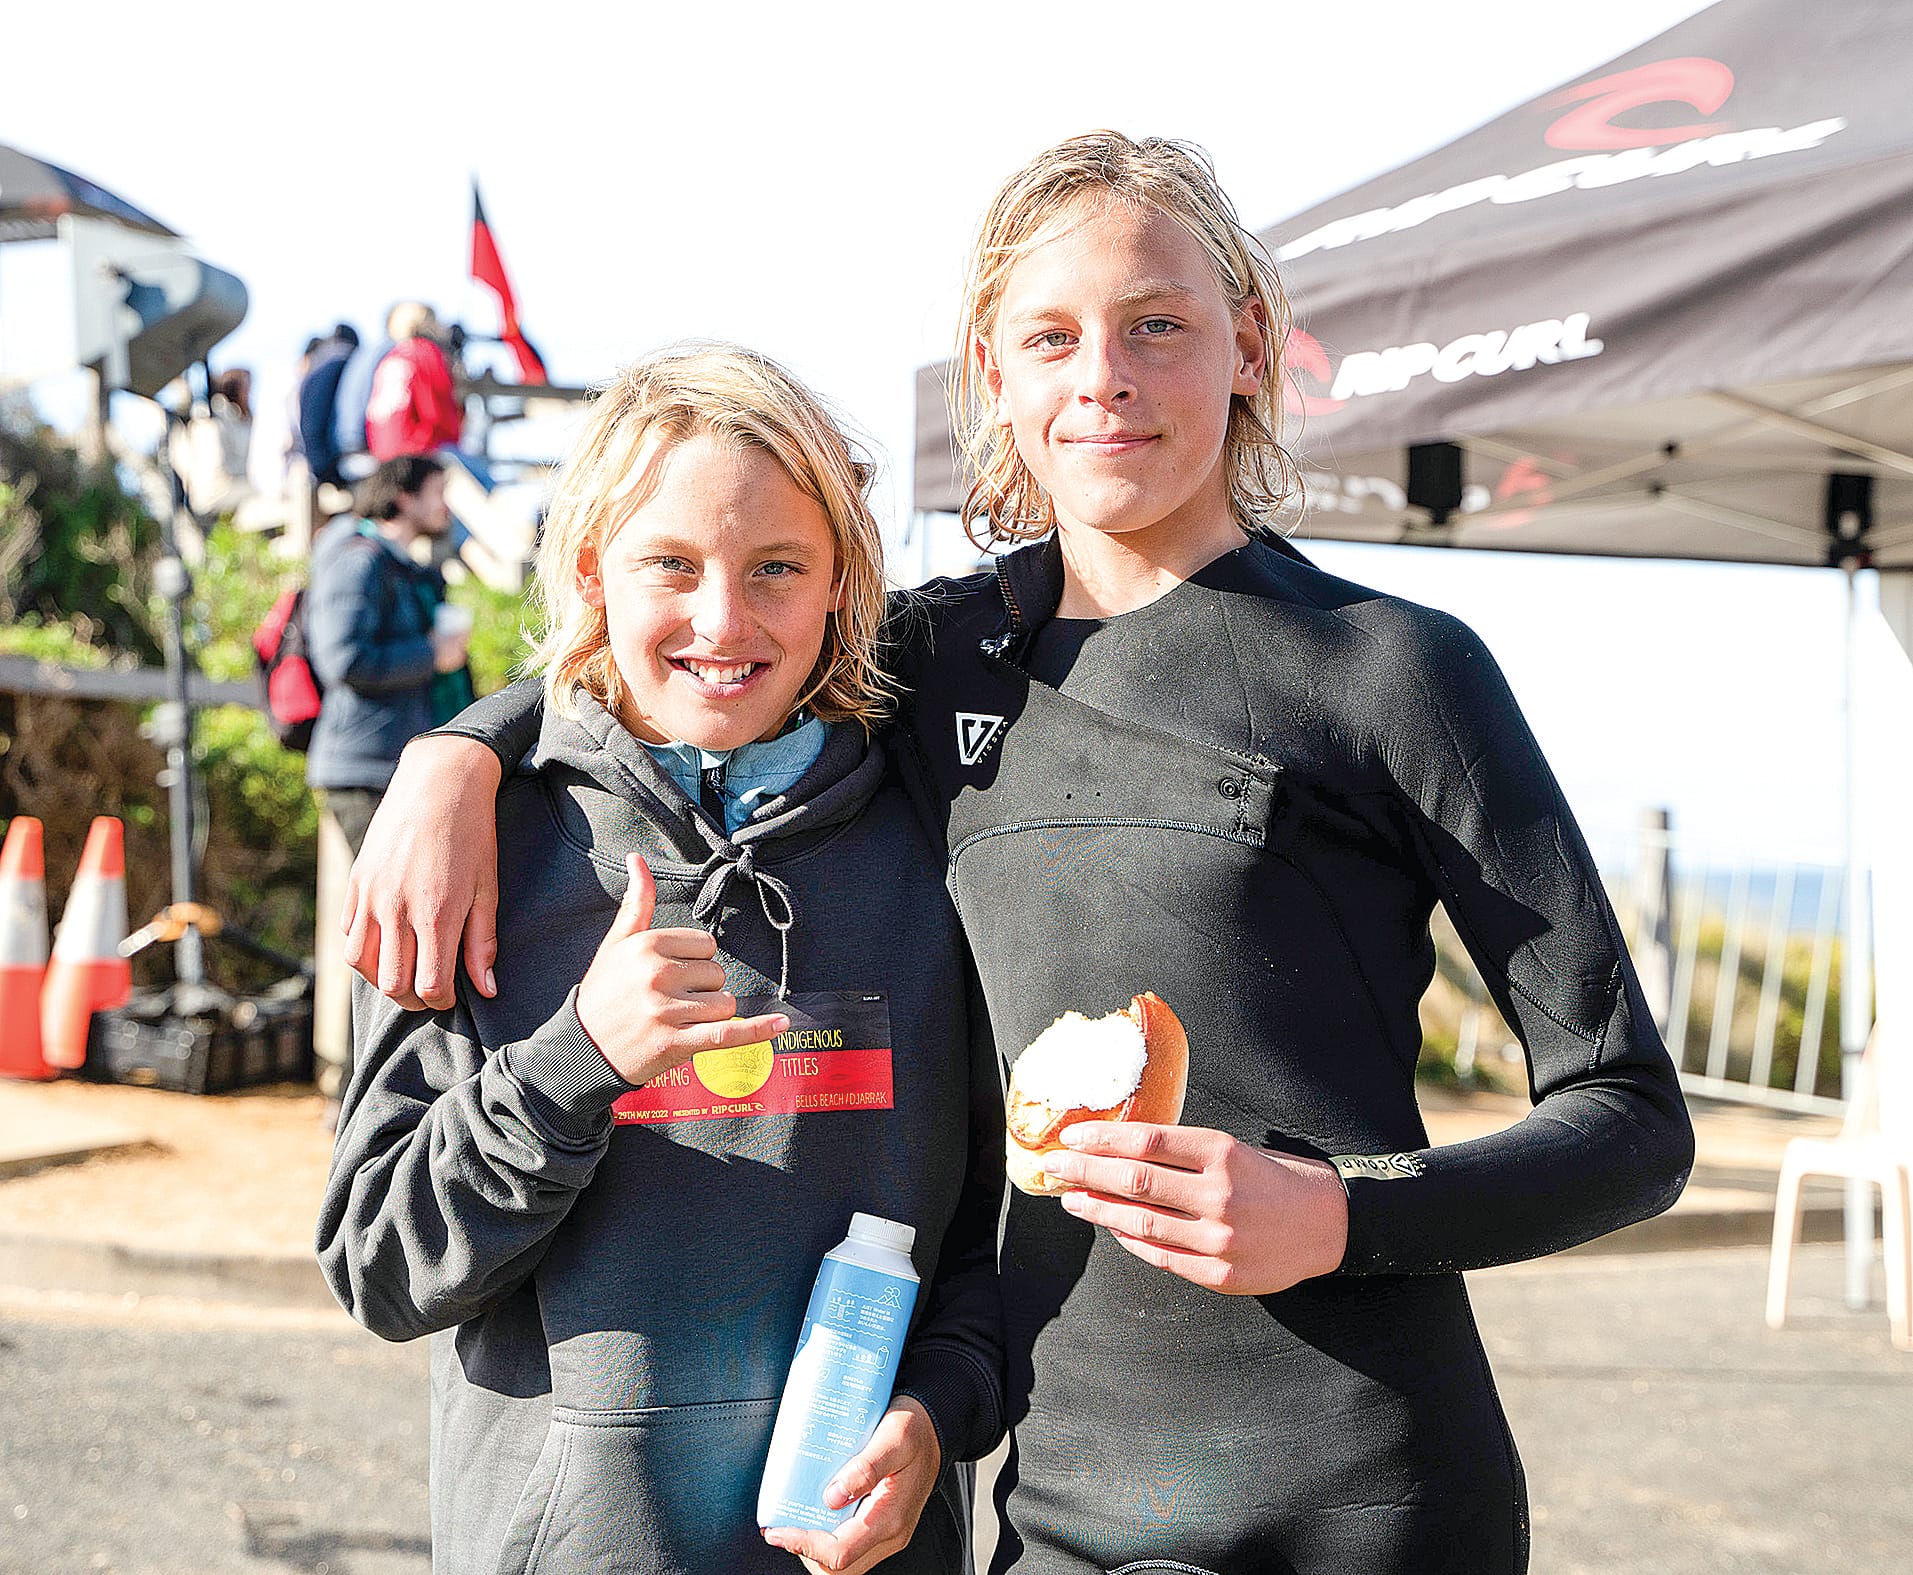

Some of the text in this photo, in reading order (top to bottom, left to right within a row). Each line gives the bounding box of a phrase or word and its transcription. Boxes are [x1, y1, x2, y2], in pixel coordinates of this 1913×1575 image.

[977, 721, 1008, 763] VISSLA
[777, 1029, 843, 1051] INDIGENOUS
[780, 1057, 819, 1077] TITLES
[795, 1094, 818, 1108] BELLS
[636, 1110, 651, 1120] MAY
[651, 1109, 669, 1119] 2022
[701, 1106, 709, 1115] BY
[1342, 1158, 1390, 1172] COMP
